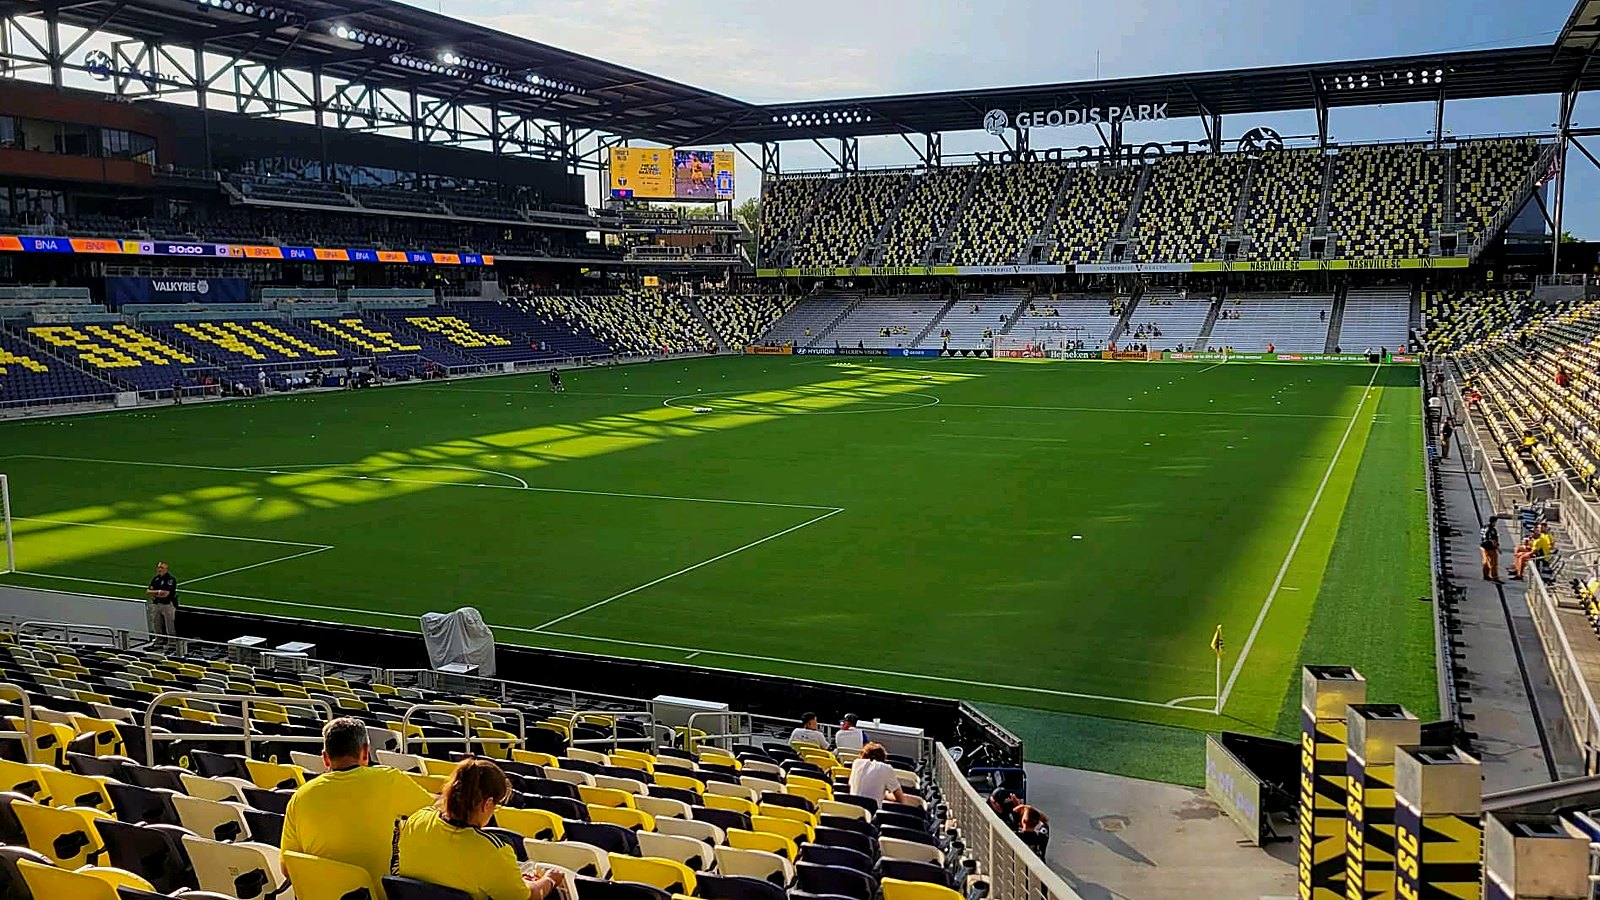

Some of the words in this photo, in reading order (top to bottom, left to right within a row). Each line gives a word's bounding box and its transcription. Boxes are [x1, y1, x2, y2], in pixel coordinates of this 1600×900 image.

[1015, 107, 1100, 129] GEODIS
[1108, 102, 1169, 123] PARK
[34, 239, 58, 251] BNA
[168, 245, 203, 254] 30:00
[290, 249, 306, 258] BNA
[355, 252, 370, 260] BNA
[1250, 261, 1288, 271] NASHVILLE
[1289, 261, 1300, 270] SC
[1348, 260, 1389, 269] NASHVILLE
[1390, 259, 1401, 269] SC
[799, 268, 828, 276] NASHVILLE
[829, 268, 837, 276] SC
[871, 267, 901, 276] NASHVILLE
[902, 267, 910, 275] SC
[152, 280, 196, 292] VALKYRIE
[1051, 350, 1089, 359] Heneken
[1111, 351, 1145, 360] Continental
[1302, 731, 1314, 773] SC
[1347, 775, 1363, 821] SC
[1397, 826, 1419, 880] SC
[1346, 820, 1363, 900] VILLE
